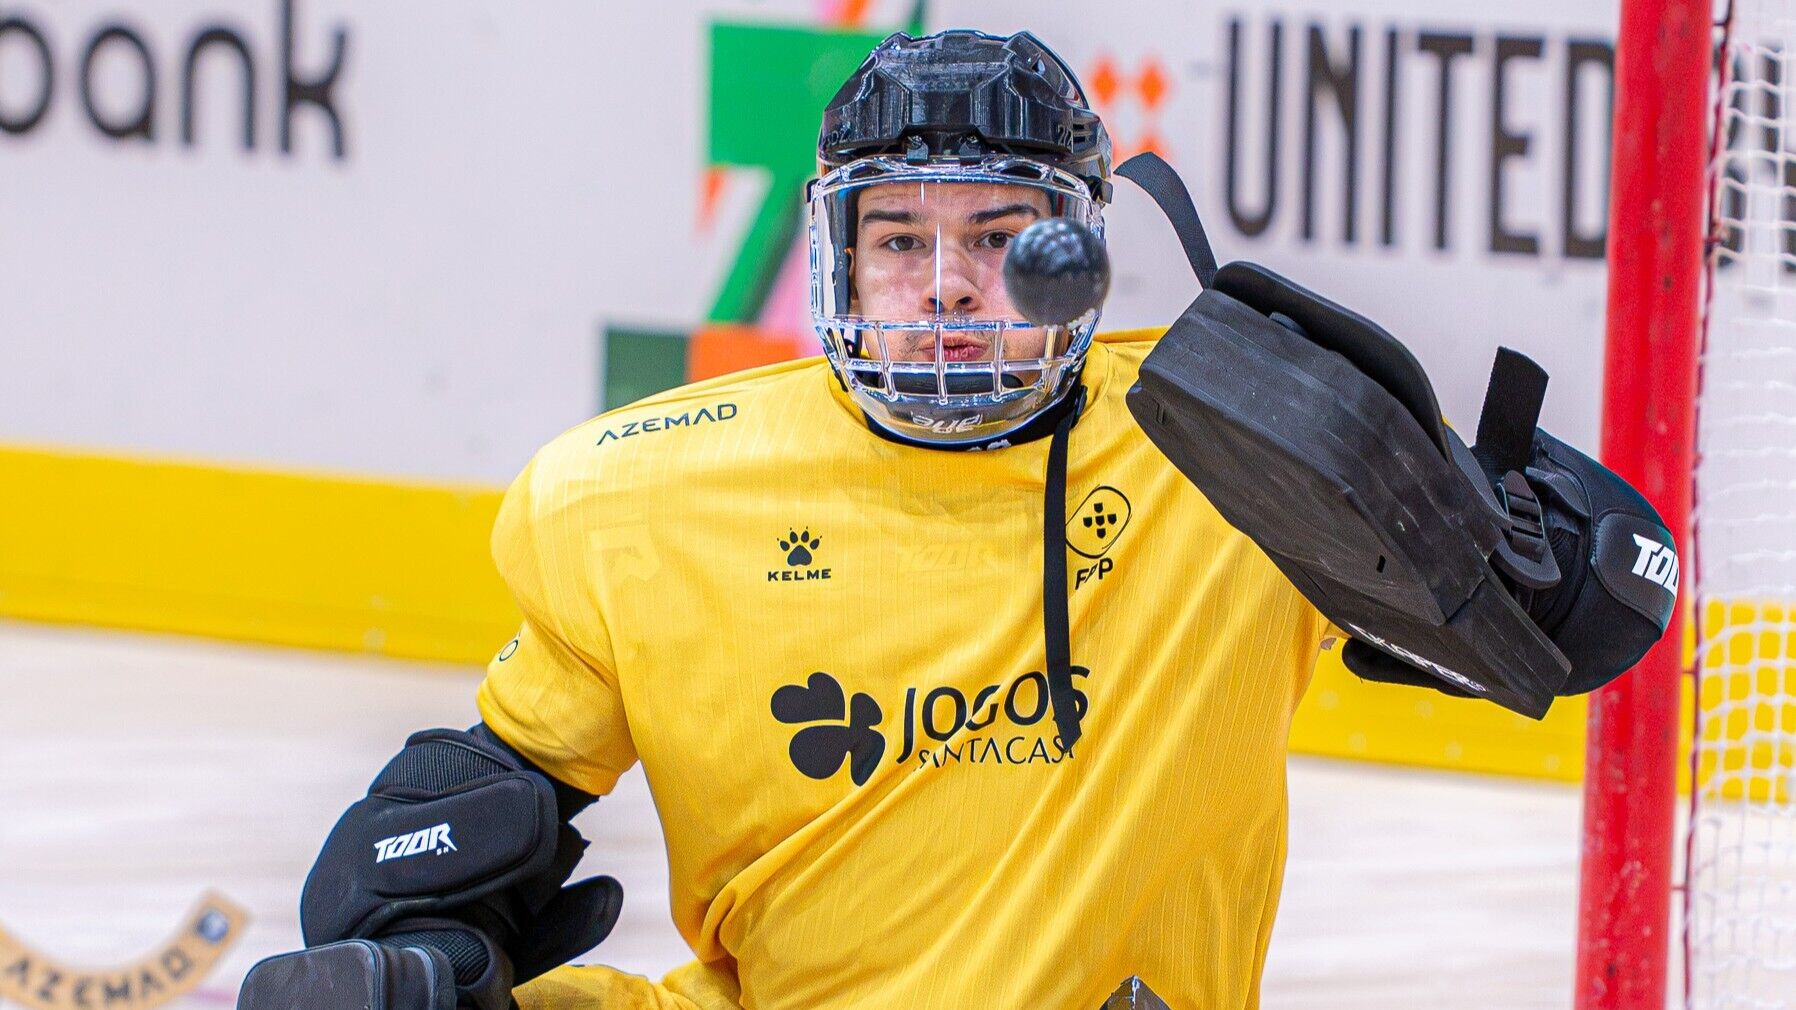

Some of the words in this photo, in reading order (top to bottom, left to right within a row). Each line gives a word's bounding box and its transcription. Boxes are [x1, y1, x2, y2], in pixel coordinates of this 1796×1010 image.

[1226, 18, 1615, 259] UNITED
[596, 403, 738, 447] AZEMAD
[767, 568, 832, 583] KELME
[373, 822, 458, 864] TOOR
[4, 944, 194, 1006] AZEMAD
